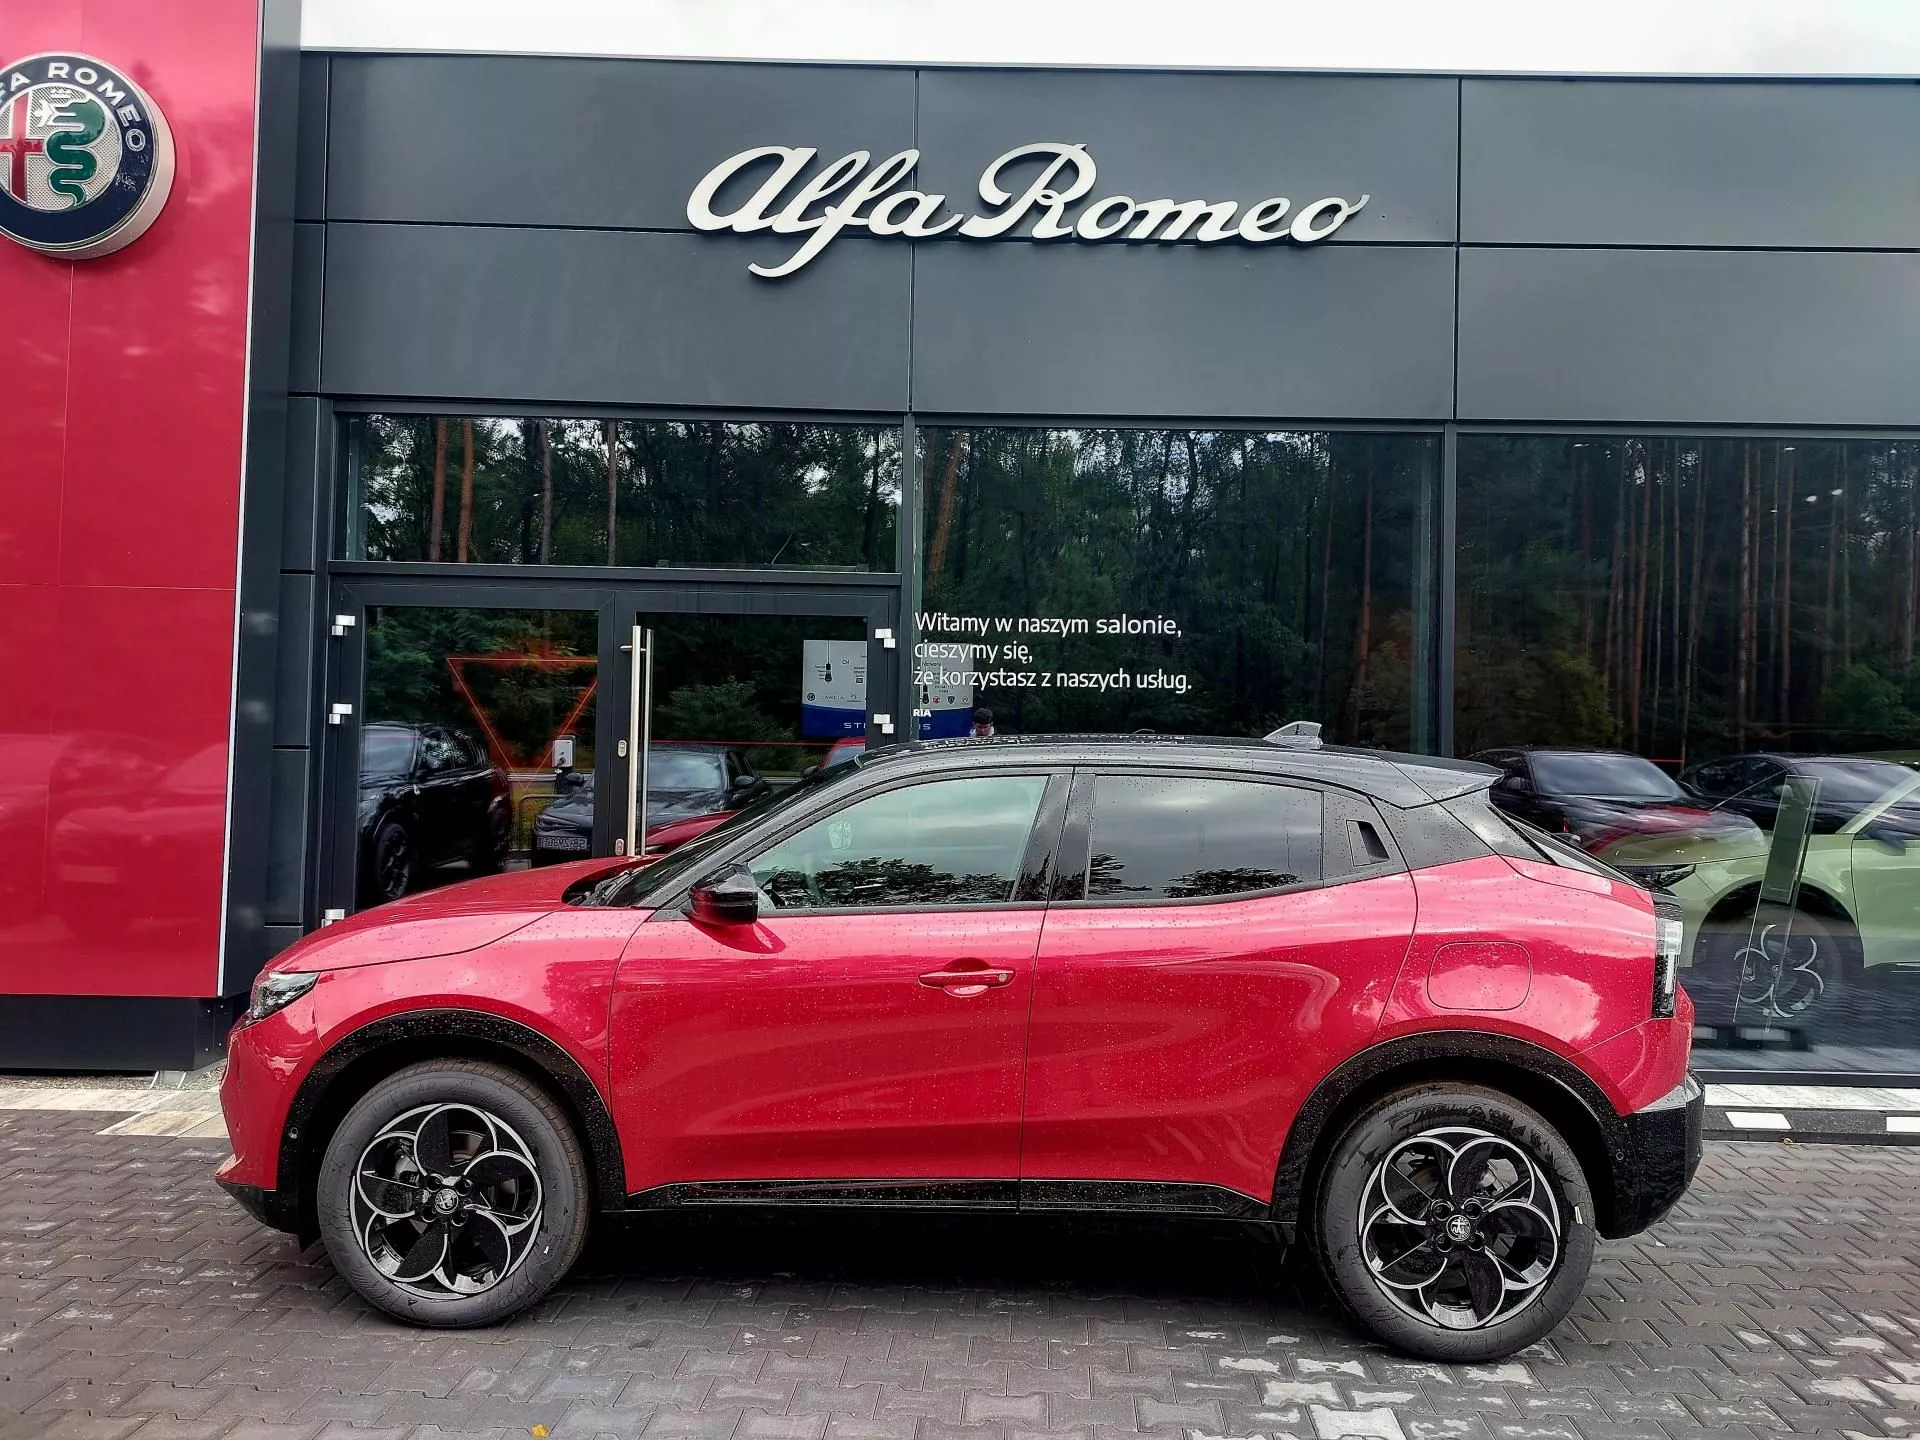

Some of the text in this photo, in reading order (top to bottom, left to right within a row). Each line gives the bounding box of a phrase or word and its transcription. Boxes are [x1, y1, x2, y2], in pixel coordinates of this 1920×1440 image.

[47, 62, 146, 152] ROMEO
[686, 142, 1370, 278] Alfa Romeo
[915, 612, 1182, 638] Witamy w naszym salonie,
[914, 639, 1033, 664] cieszymy się,
[913, 666, 934, 685] że
[940, 667, 1037, 690] korzystasz
[1041, 675, 1052, 687] z
[1056, 668, 1130, 692] naszych
[1136, 669, 1192, 694] usług.
